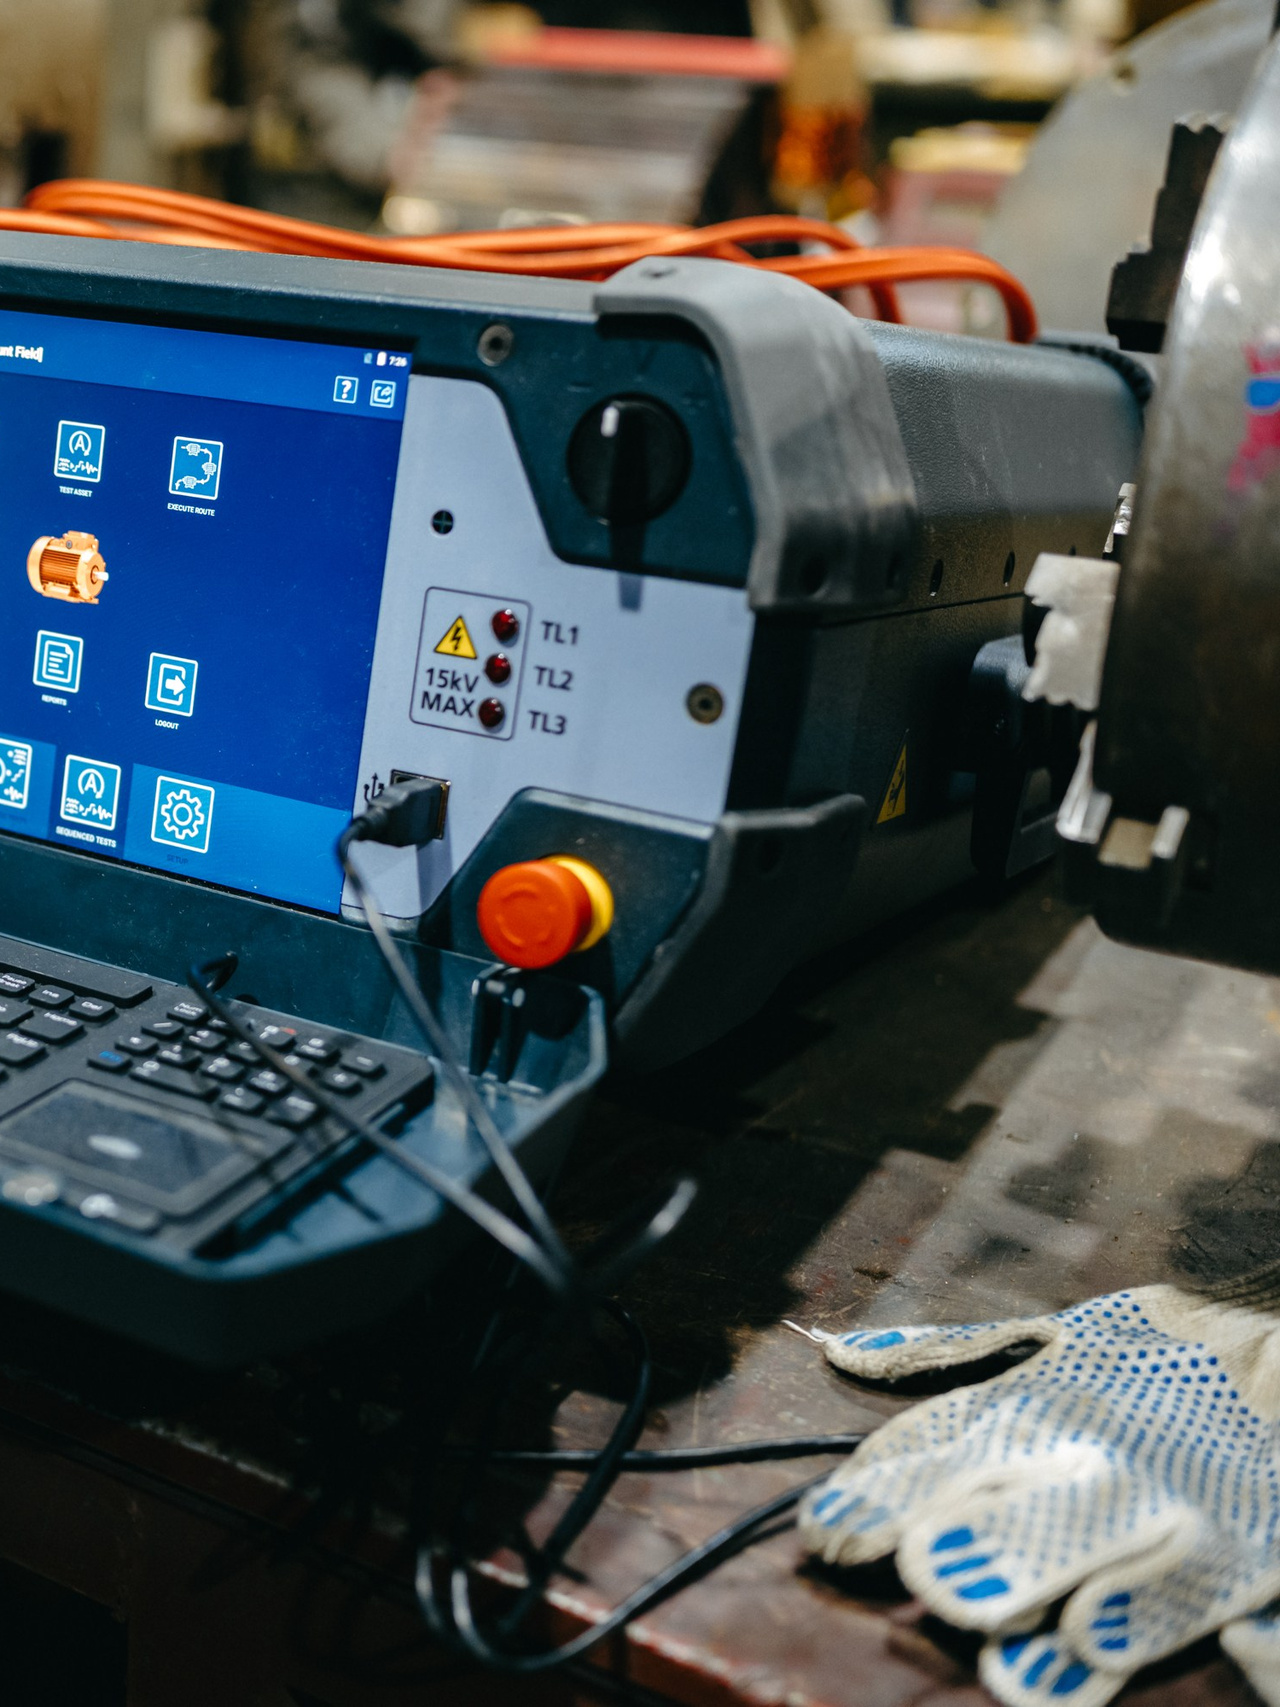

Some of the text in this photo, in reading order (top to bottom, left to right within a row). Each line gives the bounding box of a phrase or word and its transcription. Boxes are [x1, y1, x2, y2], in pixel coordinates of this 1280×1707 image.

[59, 485, 93, 498] TEST ASSET
[167, 502, 216, 516] EXECUTE ROUTE
[542, 620, 579, 646] TL1
[425, 667, 479, 693] 15kV
[534, 665, 573, 691] TL2
[421, 691, 476, 718] MAX
[154, 719, 179, 730] LOGOUT
[528, 710, 567, 735] TL3
[55, 825, 117, 848] SEQUENCED TESTS
[166, 854, 188, 865] SETUP
[81, 1001, 103, 1011] Del
